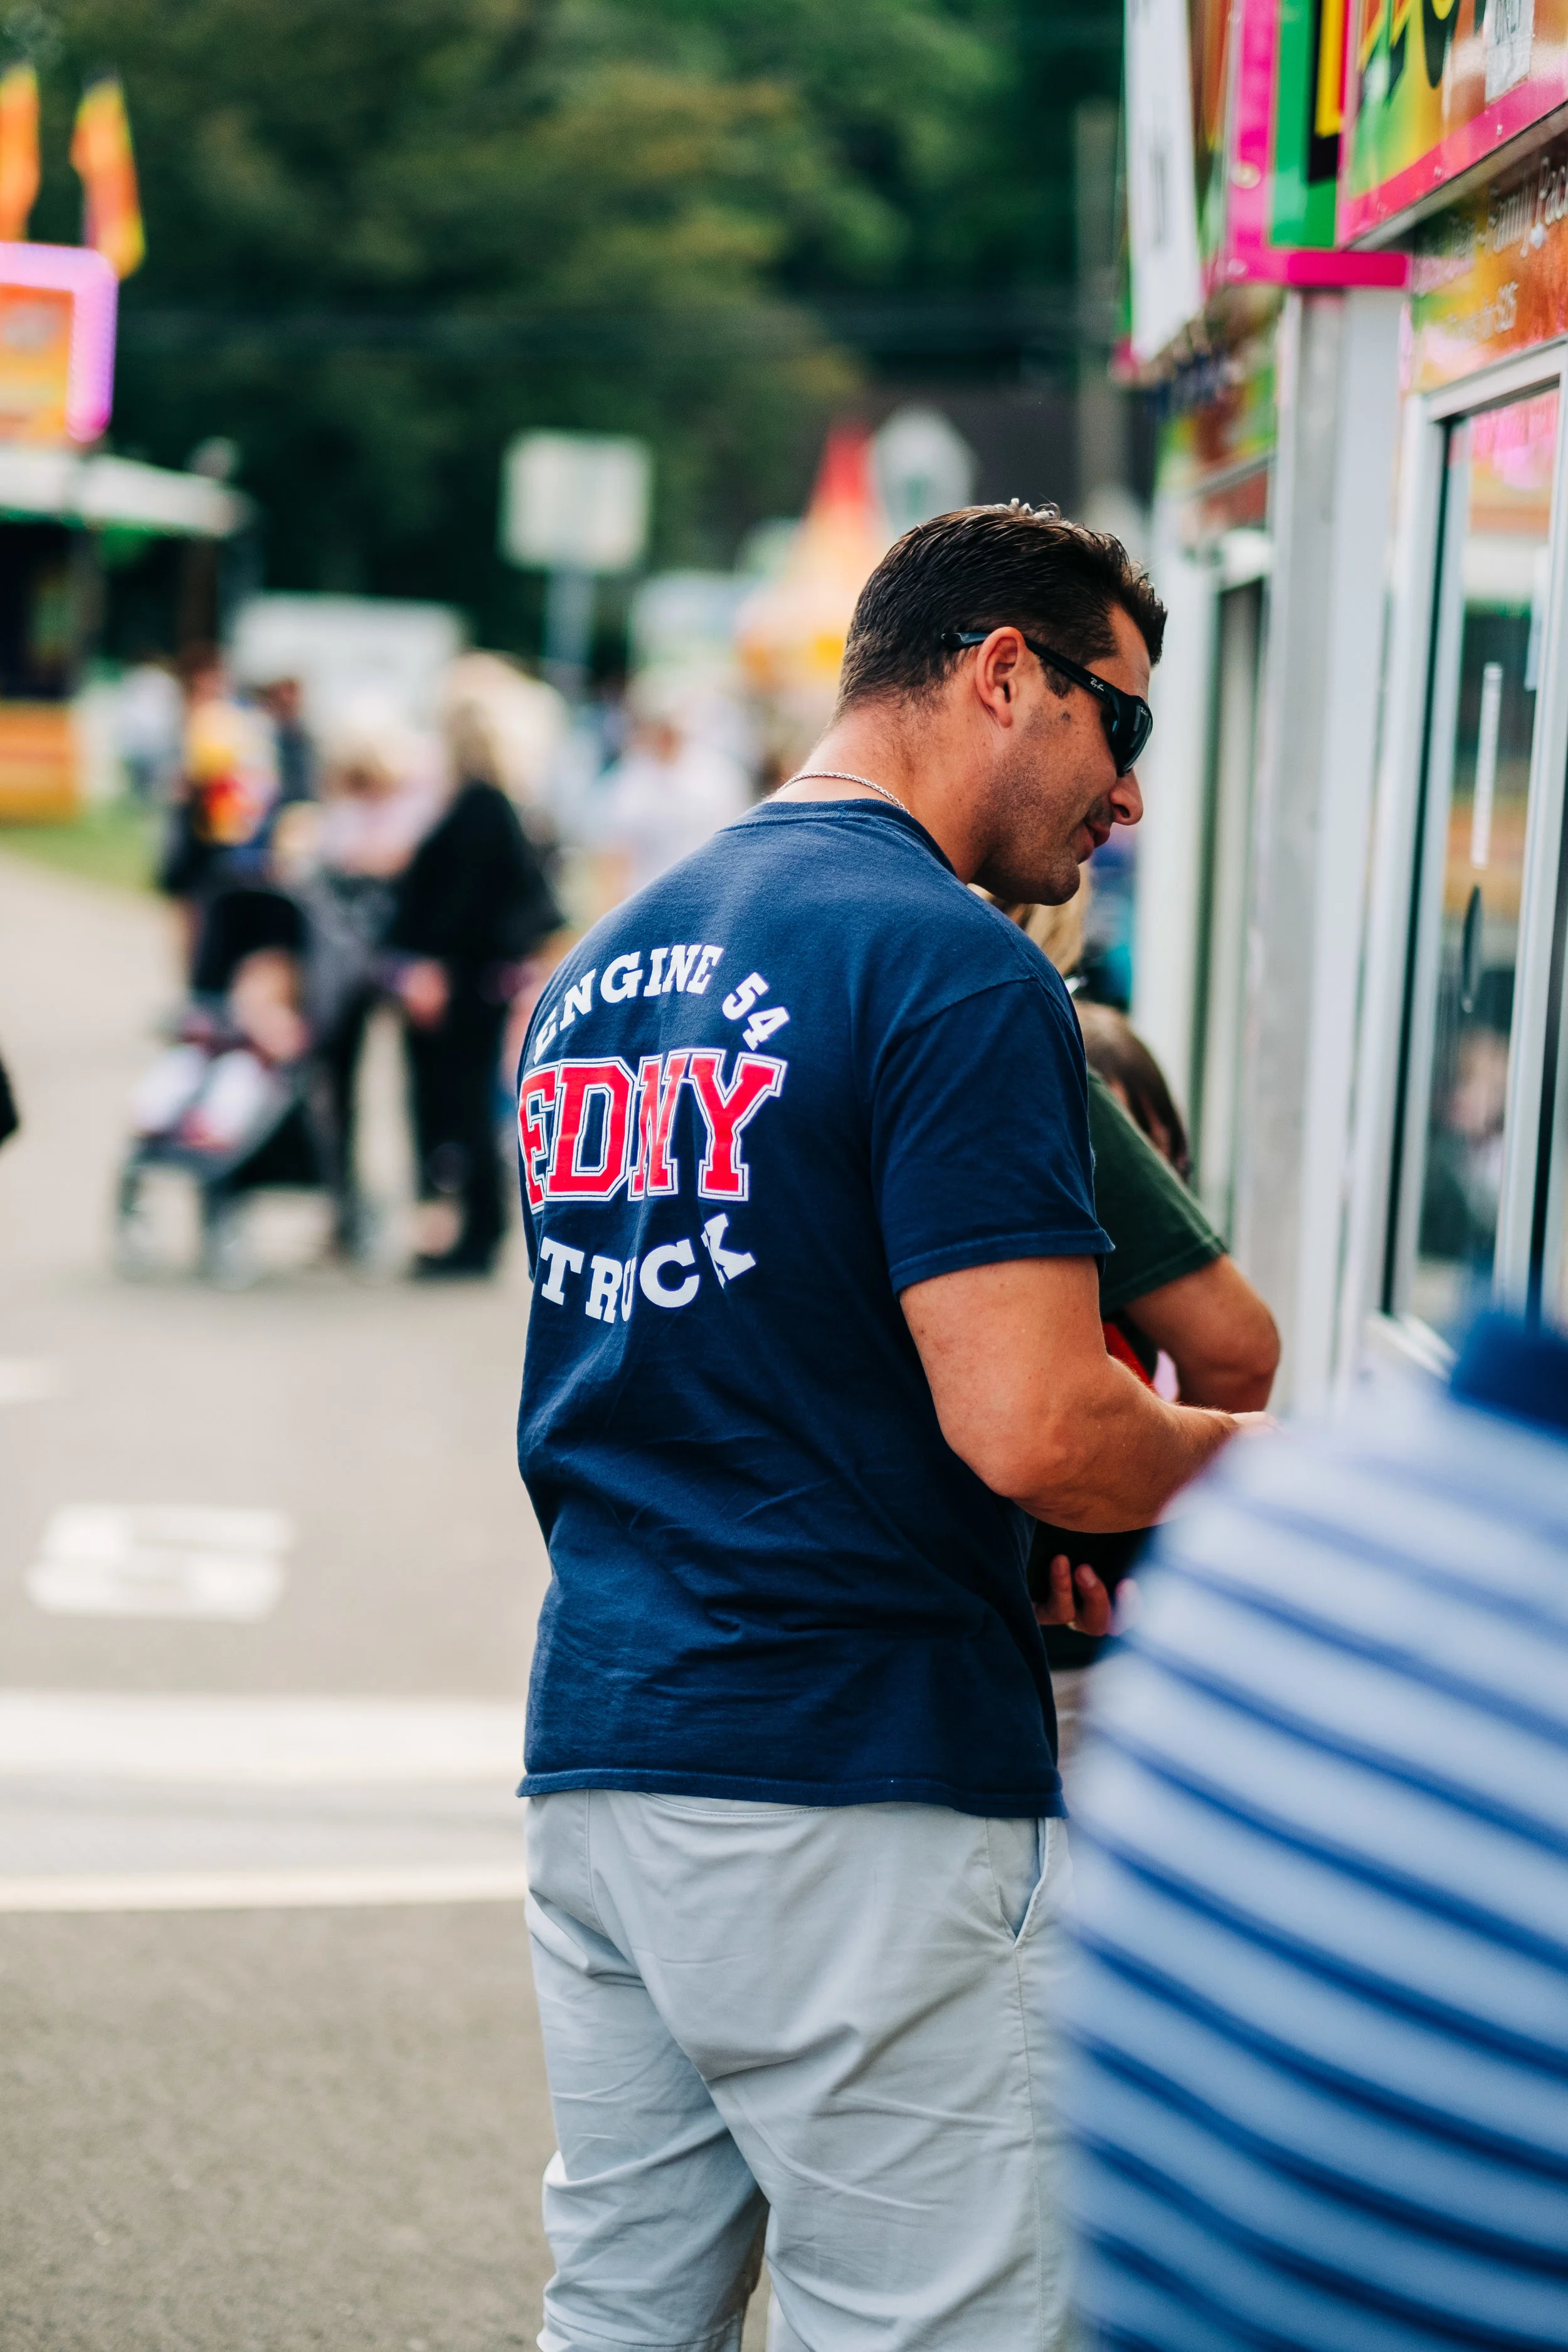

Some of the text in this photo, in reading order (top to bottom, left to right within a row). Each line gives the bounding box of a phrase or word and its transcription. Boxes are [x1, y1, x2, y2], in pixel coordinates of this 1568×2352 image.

[534, 944, 790, 1064] ENGINE 54
[518, 1048, 788, 1214] FDNY
[540, 1212, 756, 1323] TRUCK
